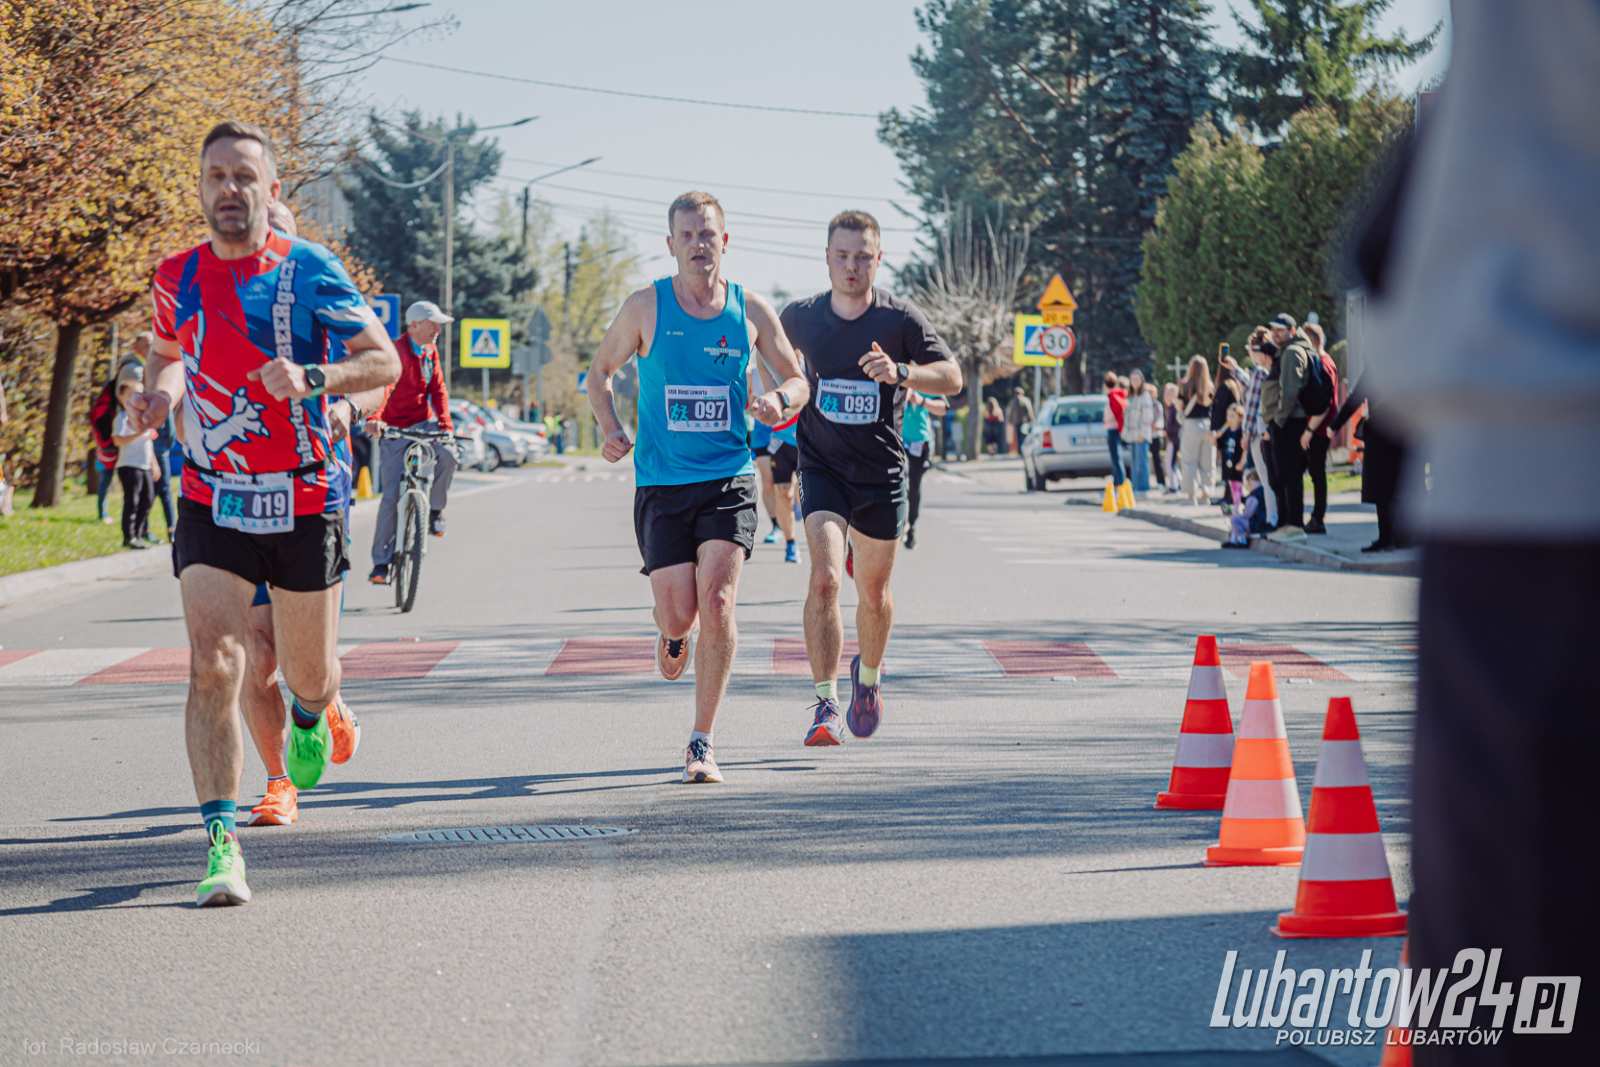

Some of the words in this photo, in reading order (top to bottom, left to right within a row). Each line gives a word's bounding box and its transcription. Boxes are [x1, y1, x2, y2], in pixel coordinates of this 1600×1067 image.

[1046, 333, 1069, 350] 30
[694, 401, 725, 419] 097
[845, 395, 874, 413] 093
[252, 492, 286, 517] 019
